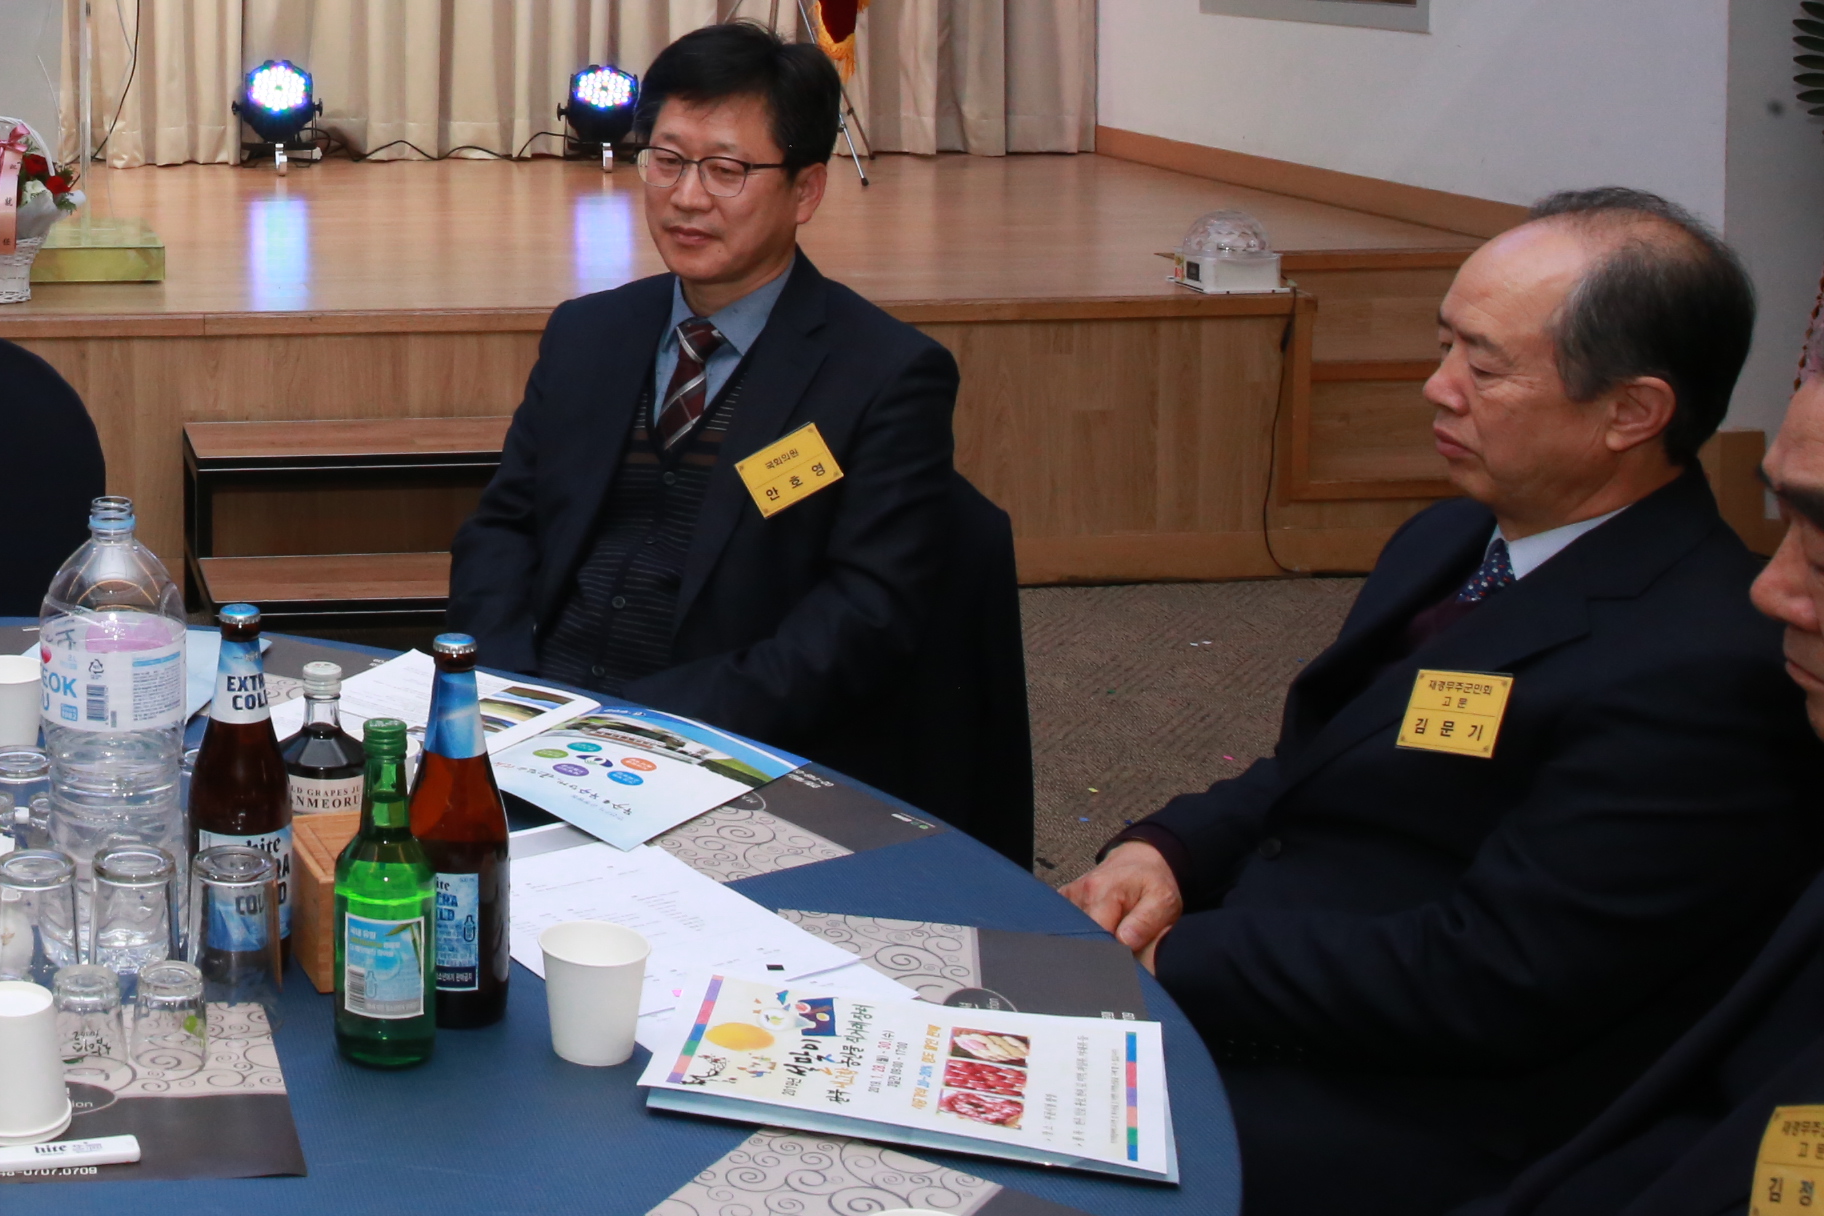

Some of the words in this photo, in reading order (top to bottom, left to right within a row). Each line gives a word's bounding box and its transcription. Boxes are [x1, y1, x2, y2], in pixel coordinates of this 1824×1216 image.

[765, 448, 799, 470] 국회의원
[766, 462, 826, 502] 안호영
[41, 667, 77, 698] EOK
[227, 673, 265, 692] EXTR
[1428, 679, 1493, 695] 재경무주군민회
[1442, 696, 1467, 709] 고문
[1414, 718, 1484, 741] 김문기
[307, 787, 348, 797] GRAPES
[436, 877, 450, 891] ite
[436, 971, 455, 982] 소년에게
[781, 1077, 801, 1096] 2019년
[34, 1144, 67, 1155] hite
